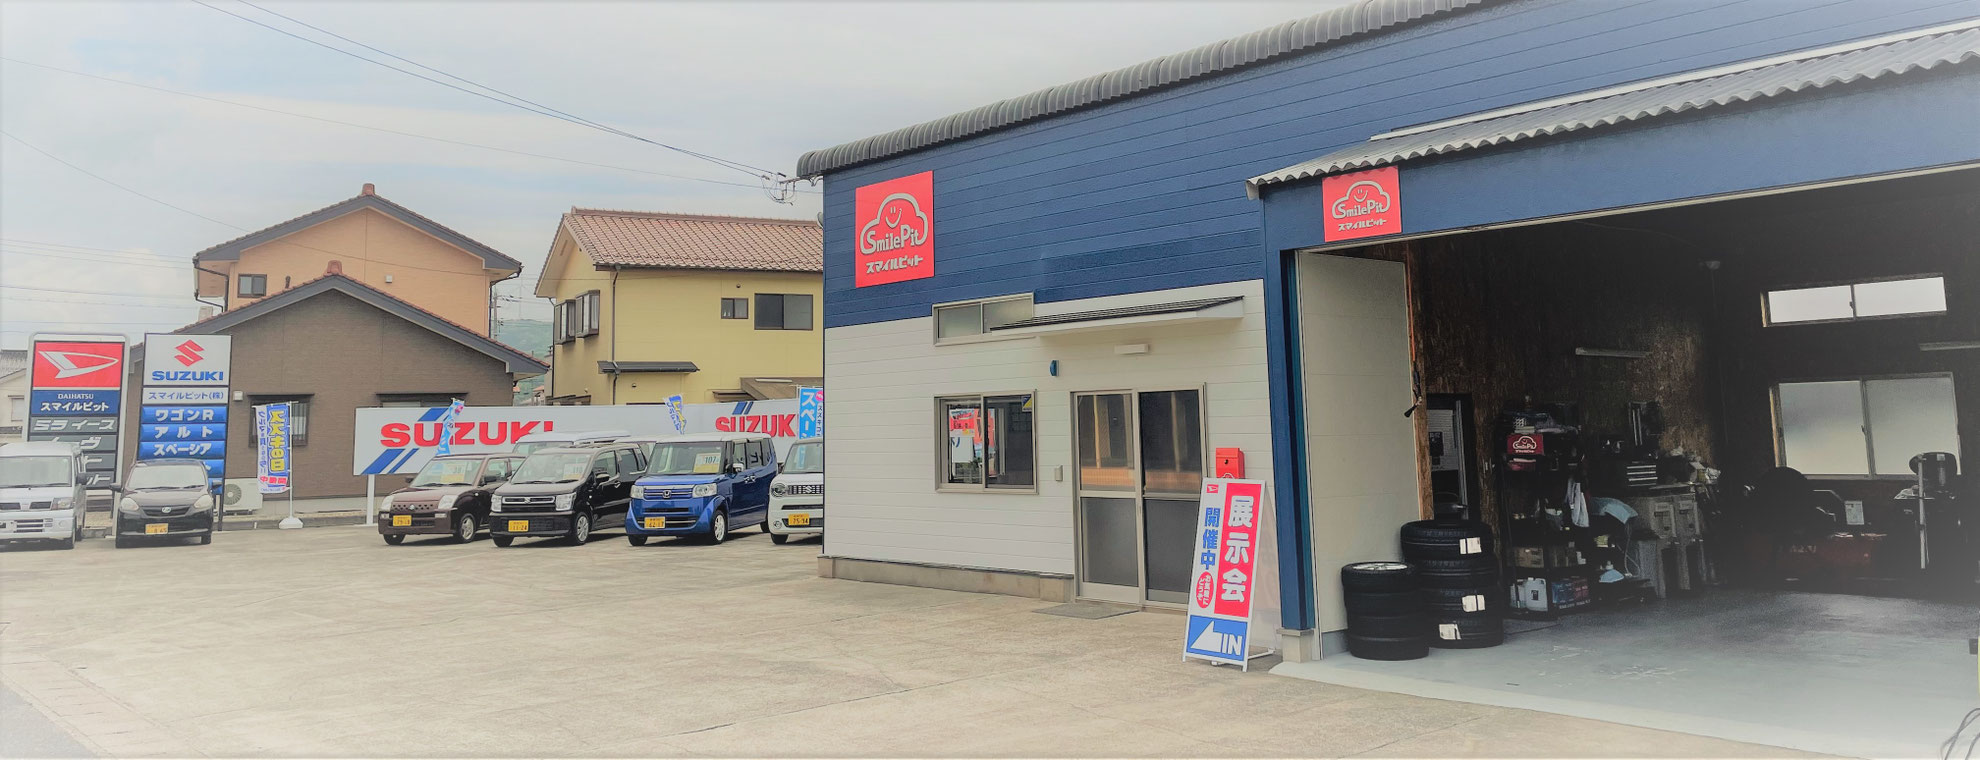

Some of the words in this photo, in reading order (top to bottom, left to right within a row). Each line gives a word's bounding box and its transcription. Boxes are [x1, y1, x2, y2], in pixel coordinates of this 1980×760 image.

[1337, 200, 1384, 218] SmilePit
[1337, 218, 1387, 231] スマイルピット
[865, 224, 921, 253] SmilePit
[866, 254, 923, 274] スマイルピット
[152, 370, 224, 381] SUZUKI
[40, 402, 109, 412] スマイルピット
[155, 409, 214, 421] ワゴンR
[716, 414, 800, 438] SUZUK
[153, 443, 212, 456] スペーシア
[1200, 507, 1221, 570] 開催中
[1221, 495, 1254, 603] 展示会
[1221, 633, 1243, 656] IN
